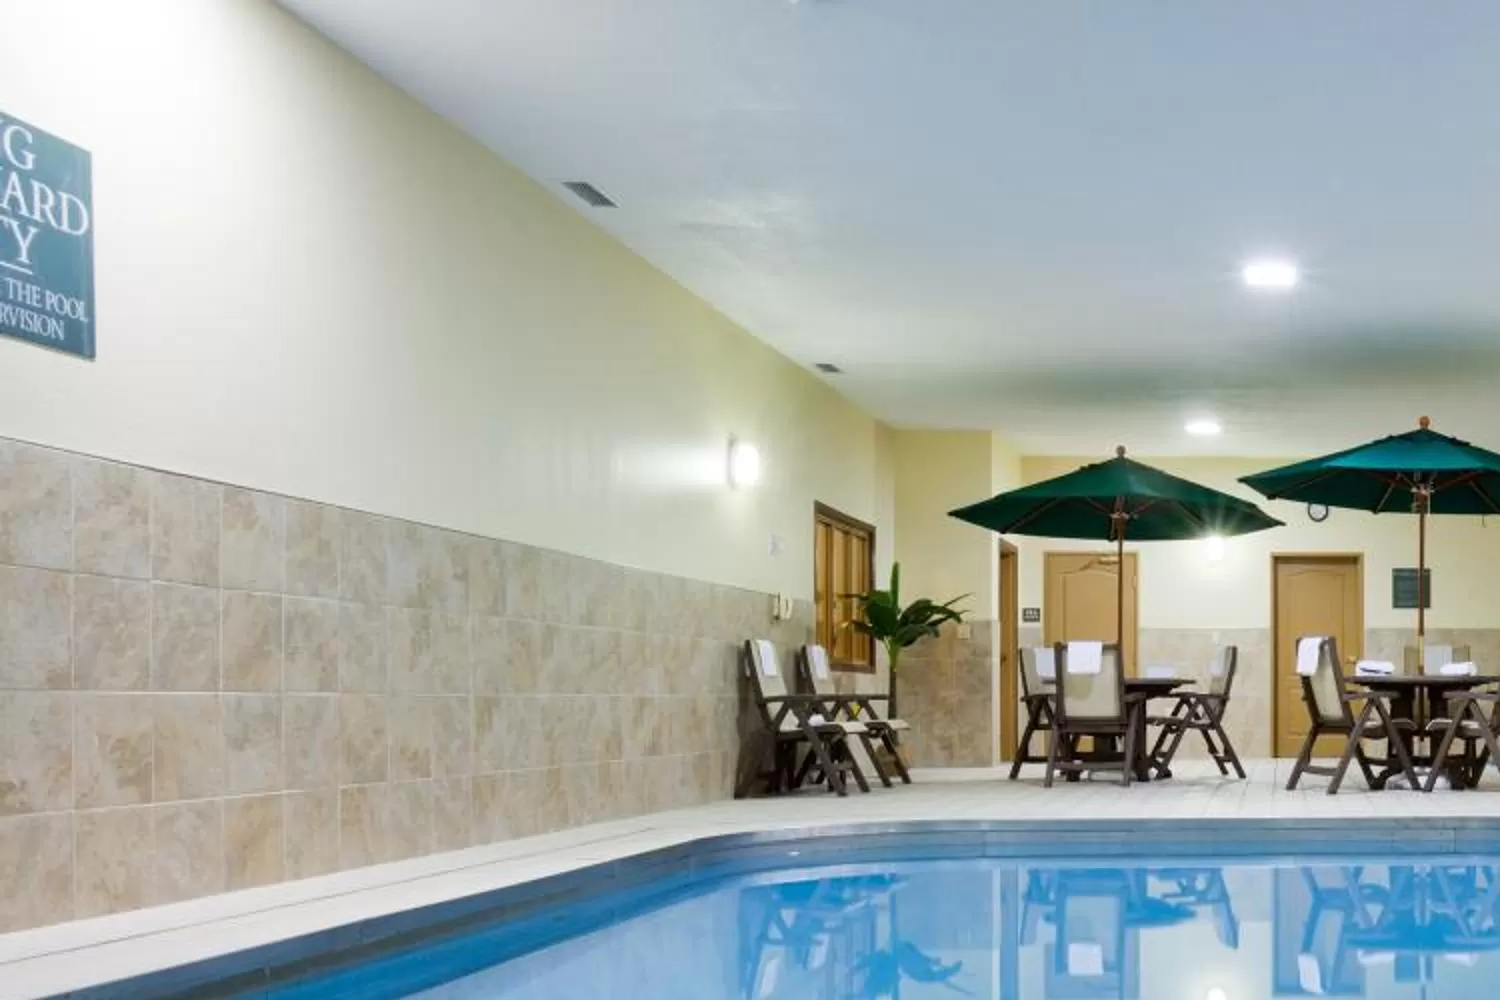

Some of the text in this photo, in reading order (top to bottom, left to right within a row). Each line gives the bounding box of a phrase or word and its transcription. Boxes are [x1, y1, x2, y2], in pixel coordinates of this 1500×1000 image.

[2, 125, 37, 170] G
[0, 171, 89, 235] ARD
[5, 216, 40, 264] Y
[4, 277, 88, 323] THE POOL
